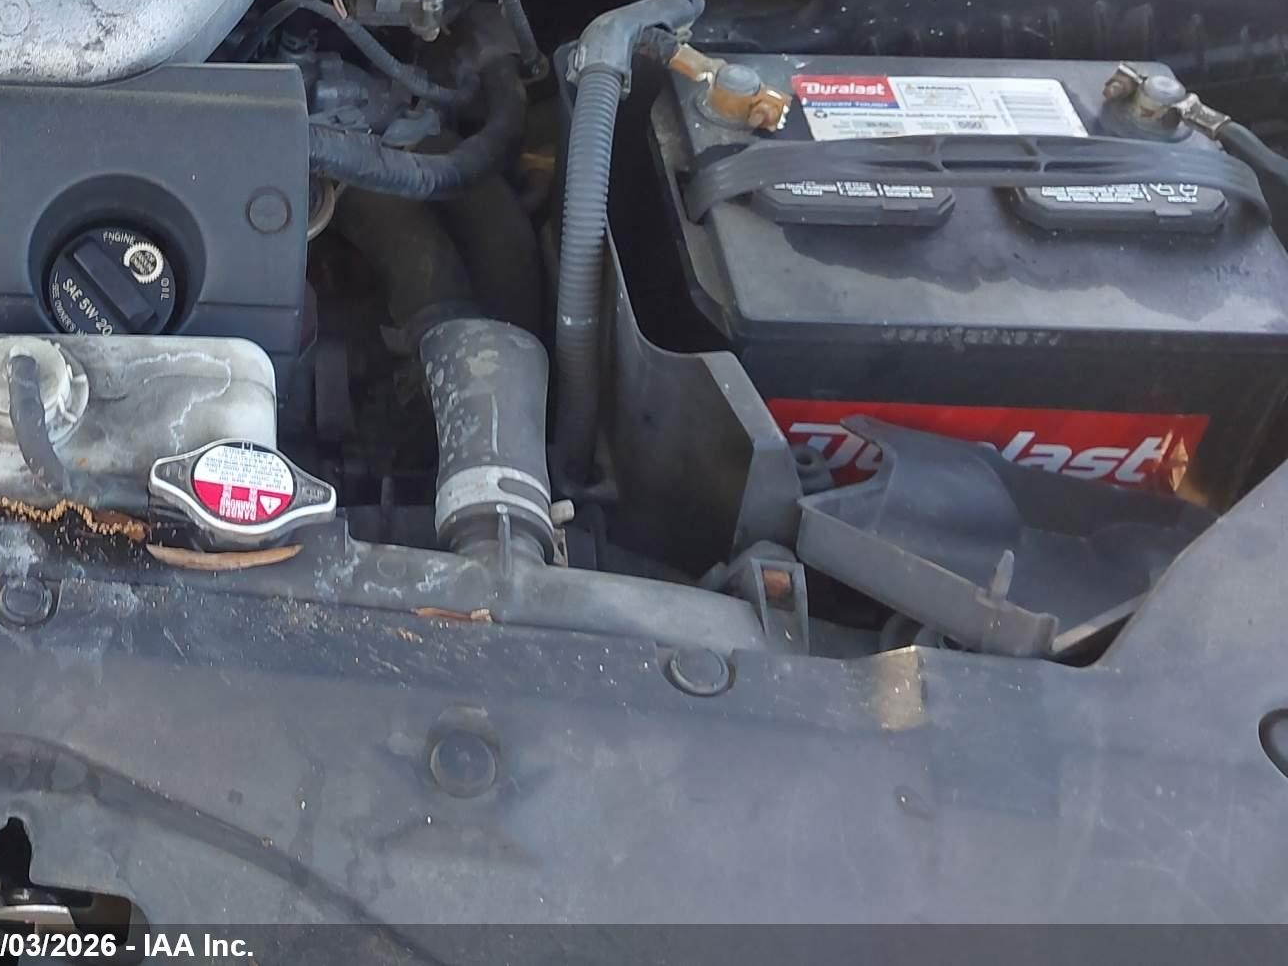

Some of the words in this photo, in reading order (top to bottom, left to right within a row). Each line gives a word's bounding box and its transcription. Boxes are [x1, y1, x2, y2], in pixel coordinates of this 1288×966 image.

[801, 81, 885, 96] Duralast
[62, 277, 83, 302] SAE
[160, 277, 170, 300] OIL
